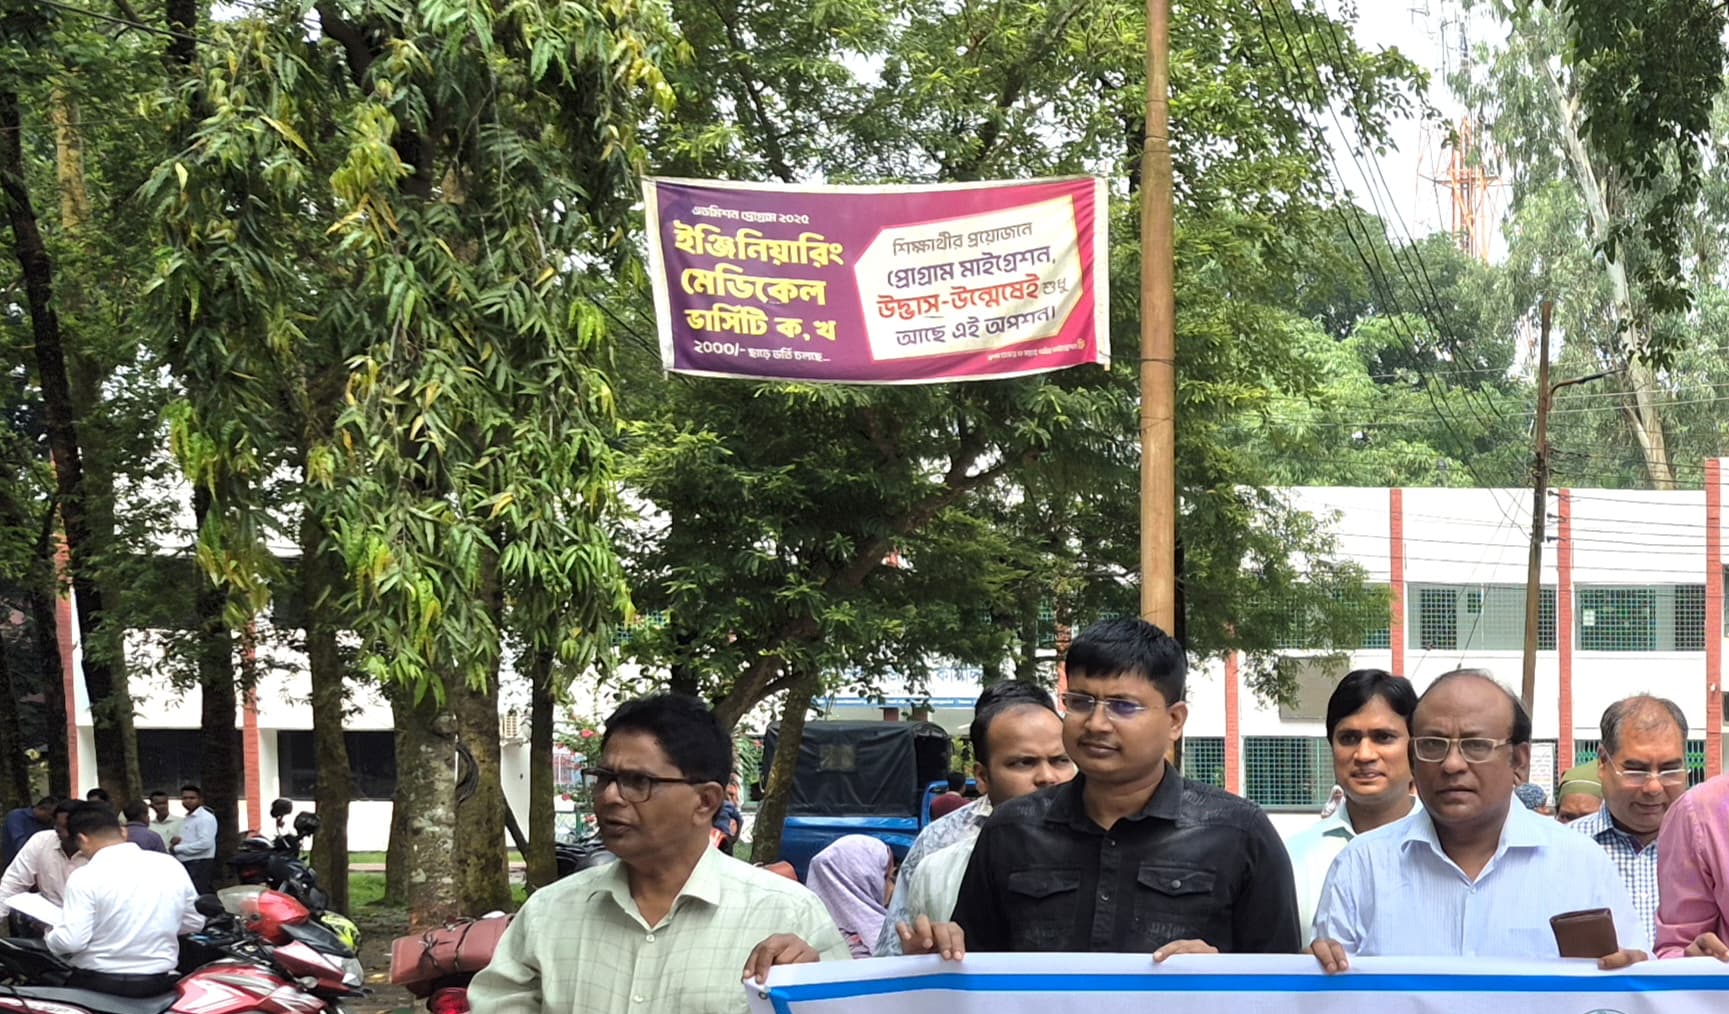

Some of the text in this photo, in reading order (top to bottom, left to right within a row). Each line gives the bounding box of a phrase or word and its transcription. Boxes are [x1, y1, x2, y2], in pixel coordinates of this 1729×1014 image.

[672, 219, 845, 269] ইঞ্জিনিয়ারিং
[967, 221, 1033, 248] প্রয়োজনে
[681, 262, 828, 306] মেডিকেল
[887, 260, 955, 289] প্রোগ্রাম
[895, 324, 947, 347] আছে
[951, 316, 981, 339] এই
